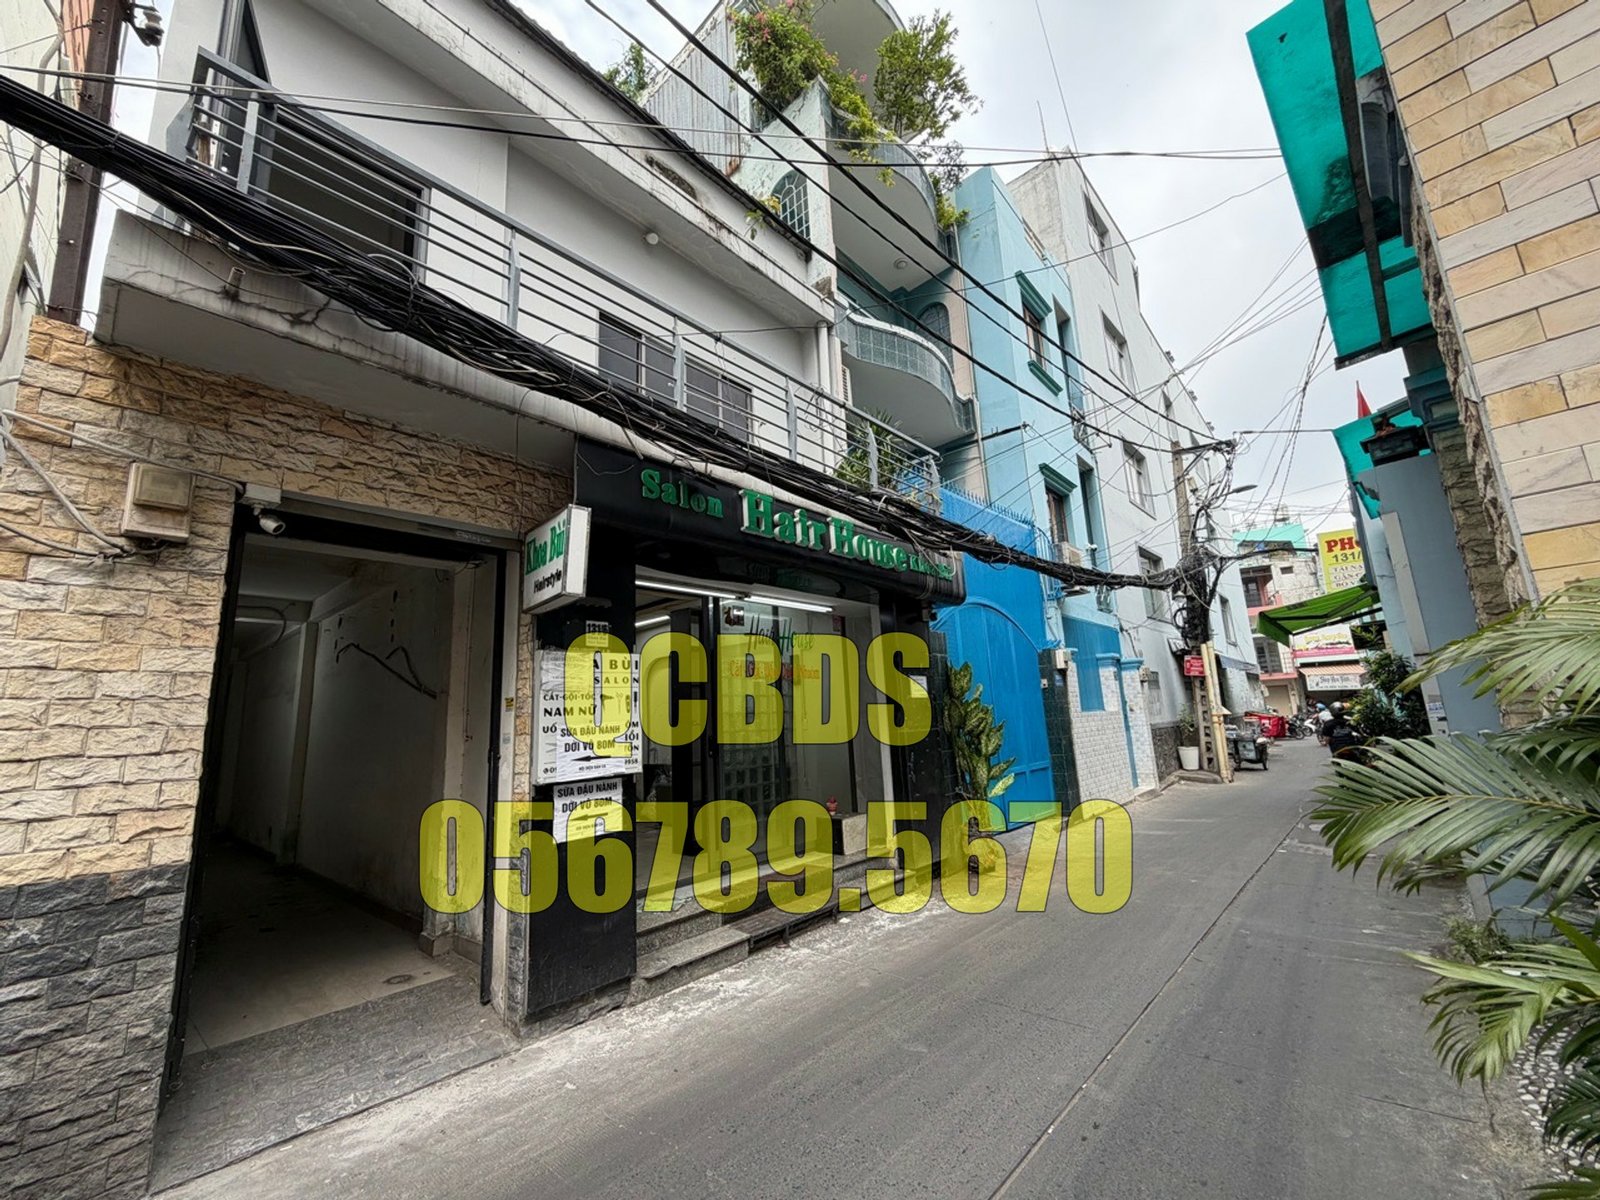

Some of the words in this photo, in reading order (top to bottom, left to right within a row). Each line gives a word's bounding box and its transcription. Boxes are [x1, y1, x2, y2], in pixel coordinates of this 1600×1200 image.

[641, 468, 724, 519] Salon
[738, 488, 828, 551] Hair
[827, 516, 908, 573] House
[1325, 536, 1360, 553] PH
[533, 568, 562, 594] Hairstyle
[609, 656, 639, 671] BÙI
[594, 676, 639, 684] SALON
[544, 706, 574, 717] NAM
[578, 703, 597, 716] NỮ
